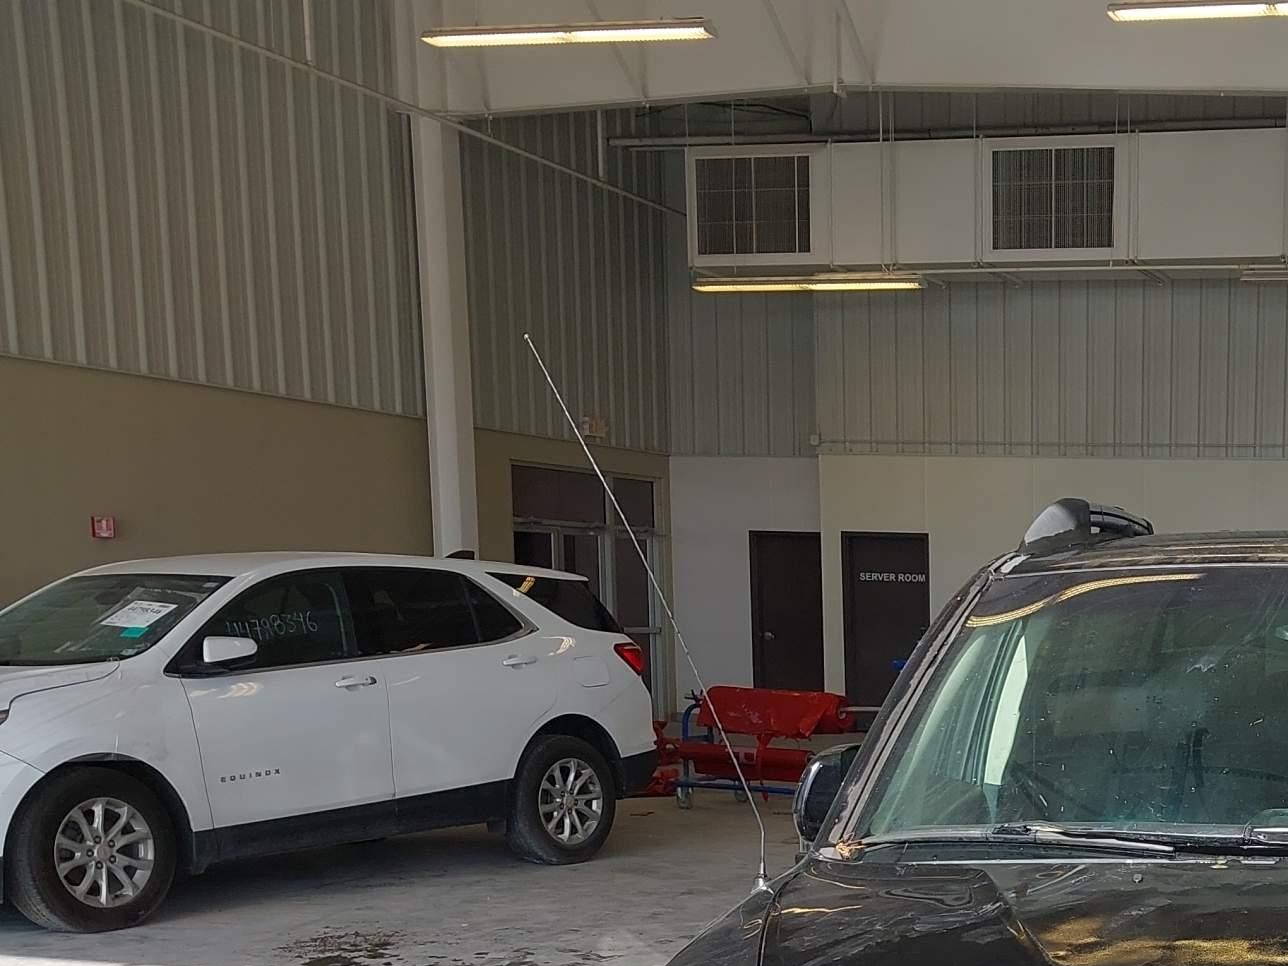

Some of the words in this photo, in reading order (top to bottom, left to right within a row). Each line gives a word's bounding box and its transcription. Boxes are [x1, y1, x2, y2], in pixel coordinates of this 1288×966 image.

[859, 573, 896, 582] SERVER
[897, 574, 926, 583] ROOM
[221, 768, 280, 783] EQUINOX
